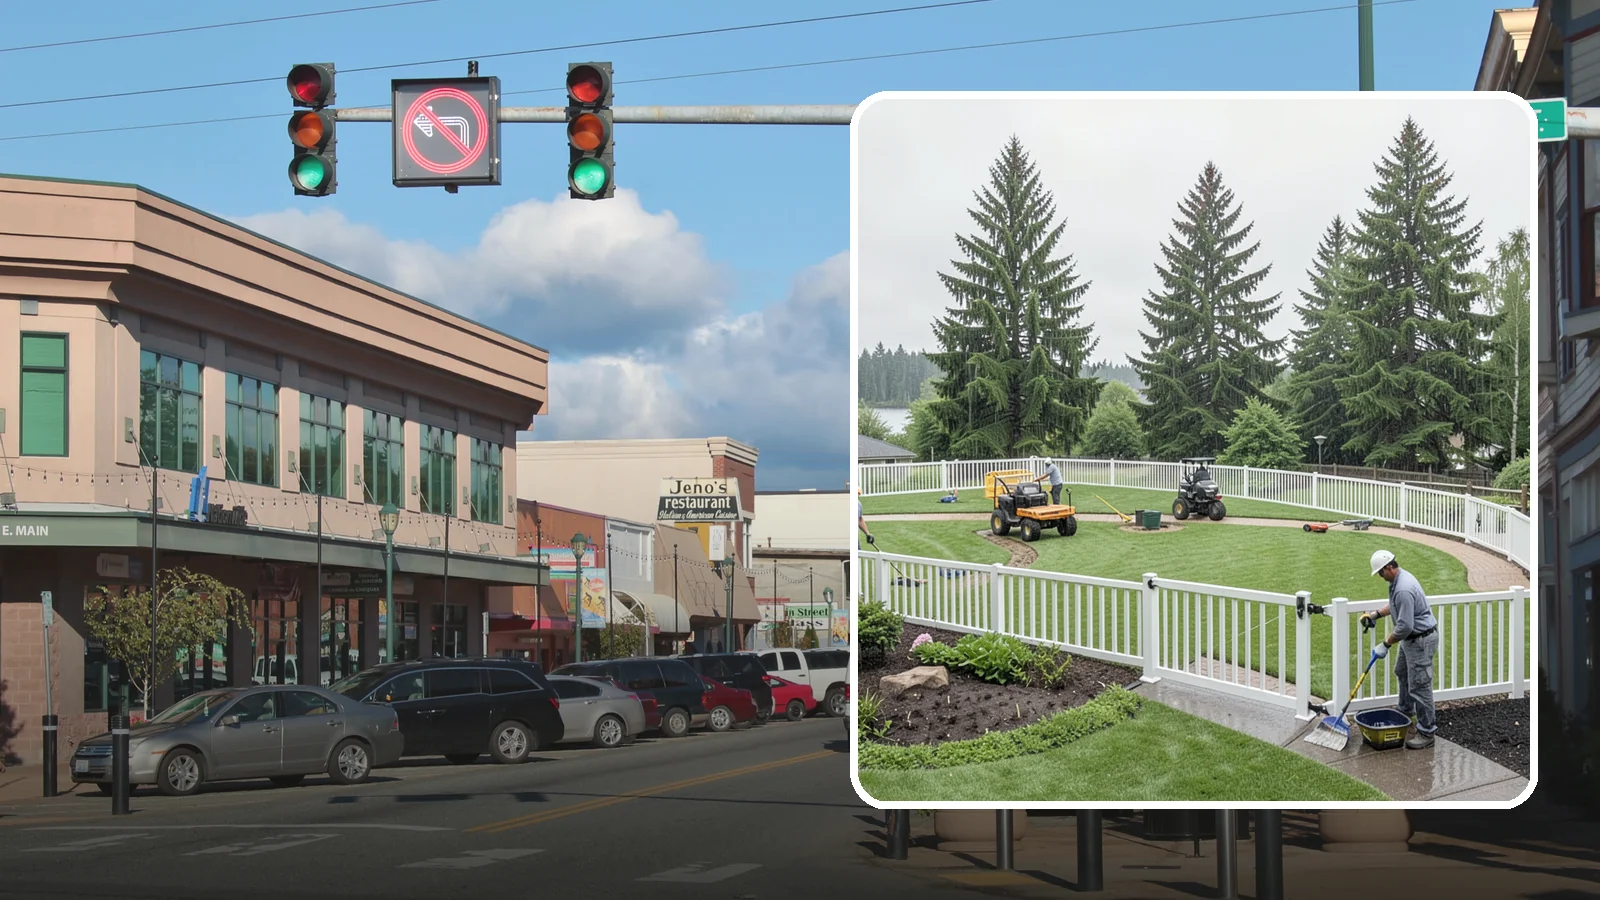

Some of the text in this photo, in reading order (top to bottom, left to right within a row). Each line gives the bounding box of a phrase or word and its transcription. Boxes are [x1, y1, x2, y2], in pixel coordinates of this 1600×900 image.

[670, 480, 727, 494] Jeno's
[665, 496, 731, 509] restaurant
[686, 509, 714, 519] American
[715, 509, 738, 519] Cuisine
[2, 525, 49, 536] E. MAIN
[797, 608, 828, 616] Street
